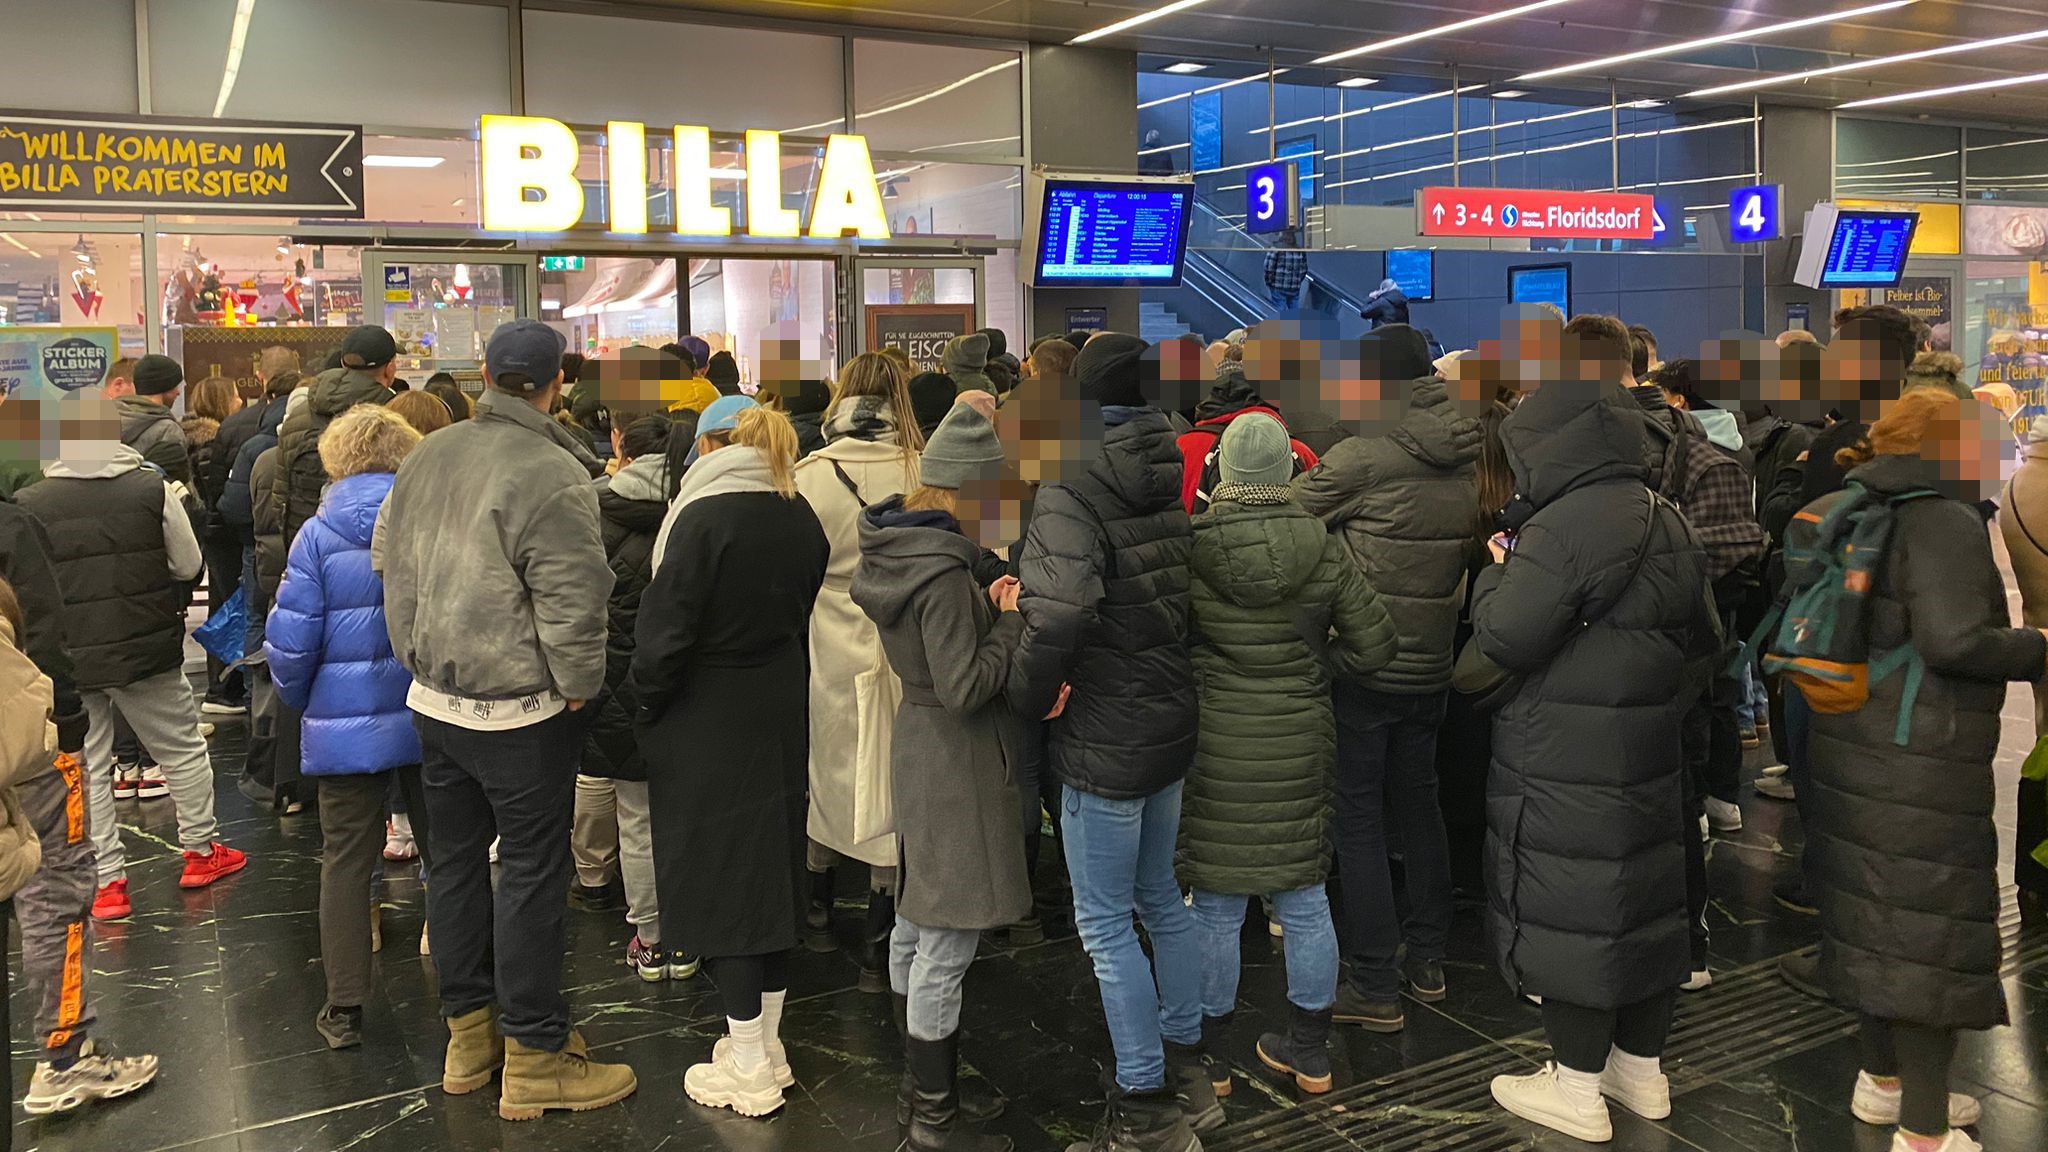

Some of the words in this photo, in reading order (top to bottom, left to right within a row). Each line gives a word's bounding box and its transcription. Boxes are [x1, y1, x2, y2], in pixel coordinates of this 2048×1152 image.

[22, 128, 242, 167] WILLKOMMEN
[253, 141, 287, 170] IM
[0, 162, 81, 193] BILLA
[93, 165, 288, 198] PRATERSTERN
[480, 113, 891, 239] BILLA
[1255, 175, 1276, 222] 3
[1547, 206, 1641, 230] Floridsdorf
[1737, 194, 1766, 233] 4
[1887, 289, 1912, 303] Felber
[1926, 287, 1943, 302] Bio-
[1070, 315, 1101, 324] Entwerter
[885, 331, 897, 340] FÜR
[898, 332, 907, 340] SIE
[908, 331, 955, 340] ZUGESCHNITTEN
[44, 347, 105, 358] STICKER
[885, 340, 948, 359] EISC
[49, 358, 101, 369] ALBUM
[1979, 362, 2002, 383] und
